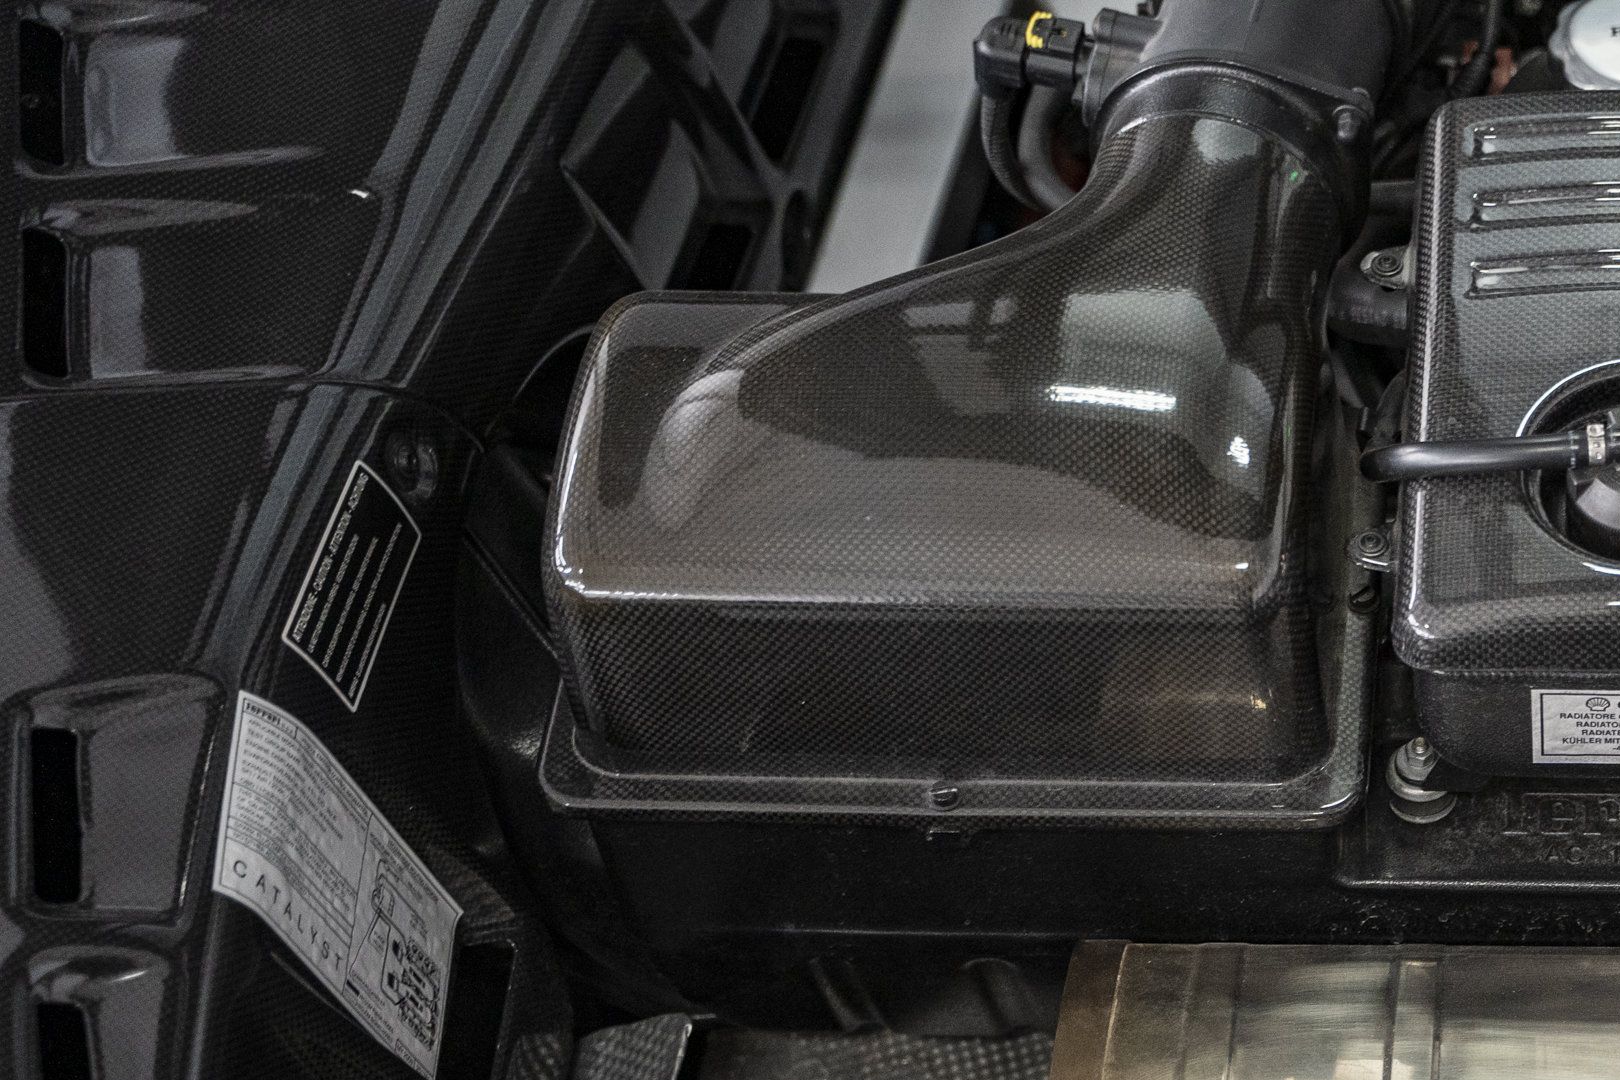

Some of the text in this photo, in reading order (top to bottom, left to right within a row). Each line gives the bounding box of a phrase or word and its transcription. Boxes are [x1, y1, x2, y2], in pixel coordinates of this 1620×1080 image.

[1559, 712, 1616, 720] RADIATORE
[1562, 736, 1602, 744] KÜHLER
[233, 860, 343, 971] CATALYST
